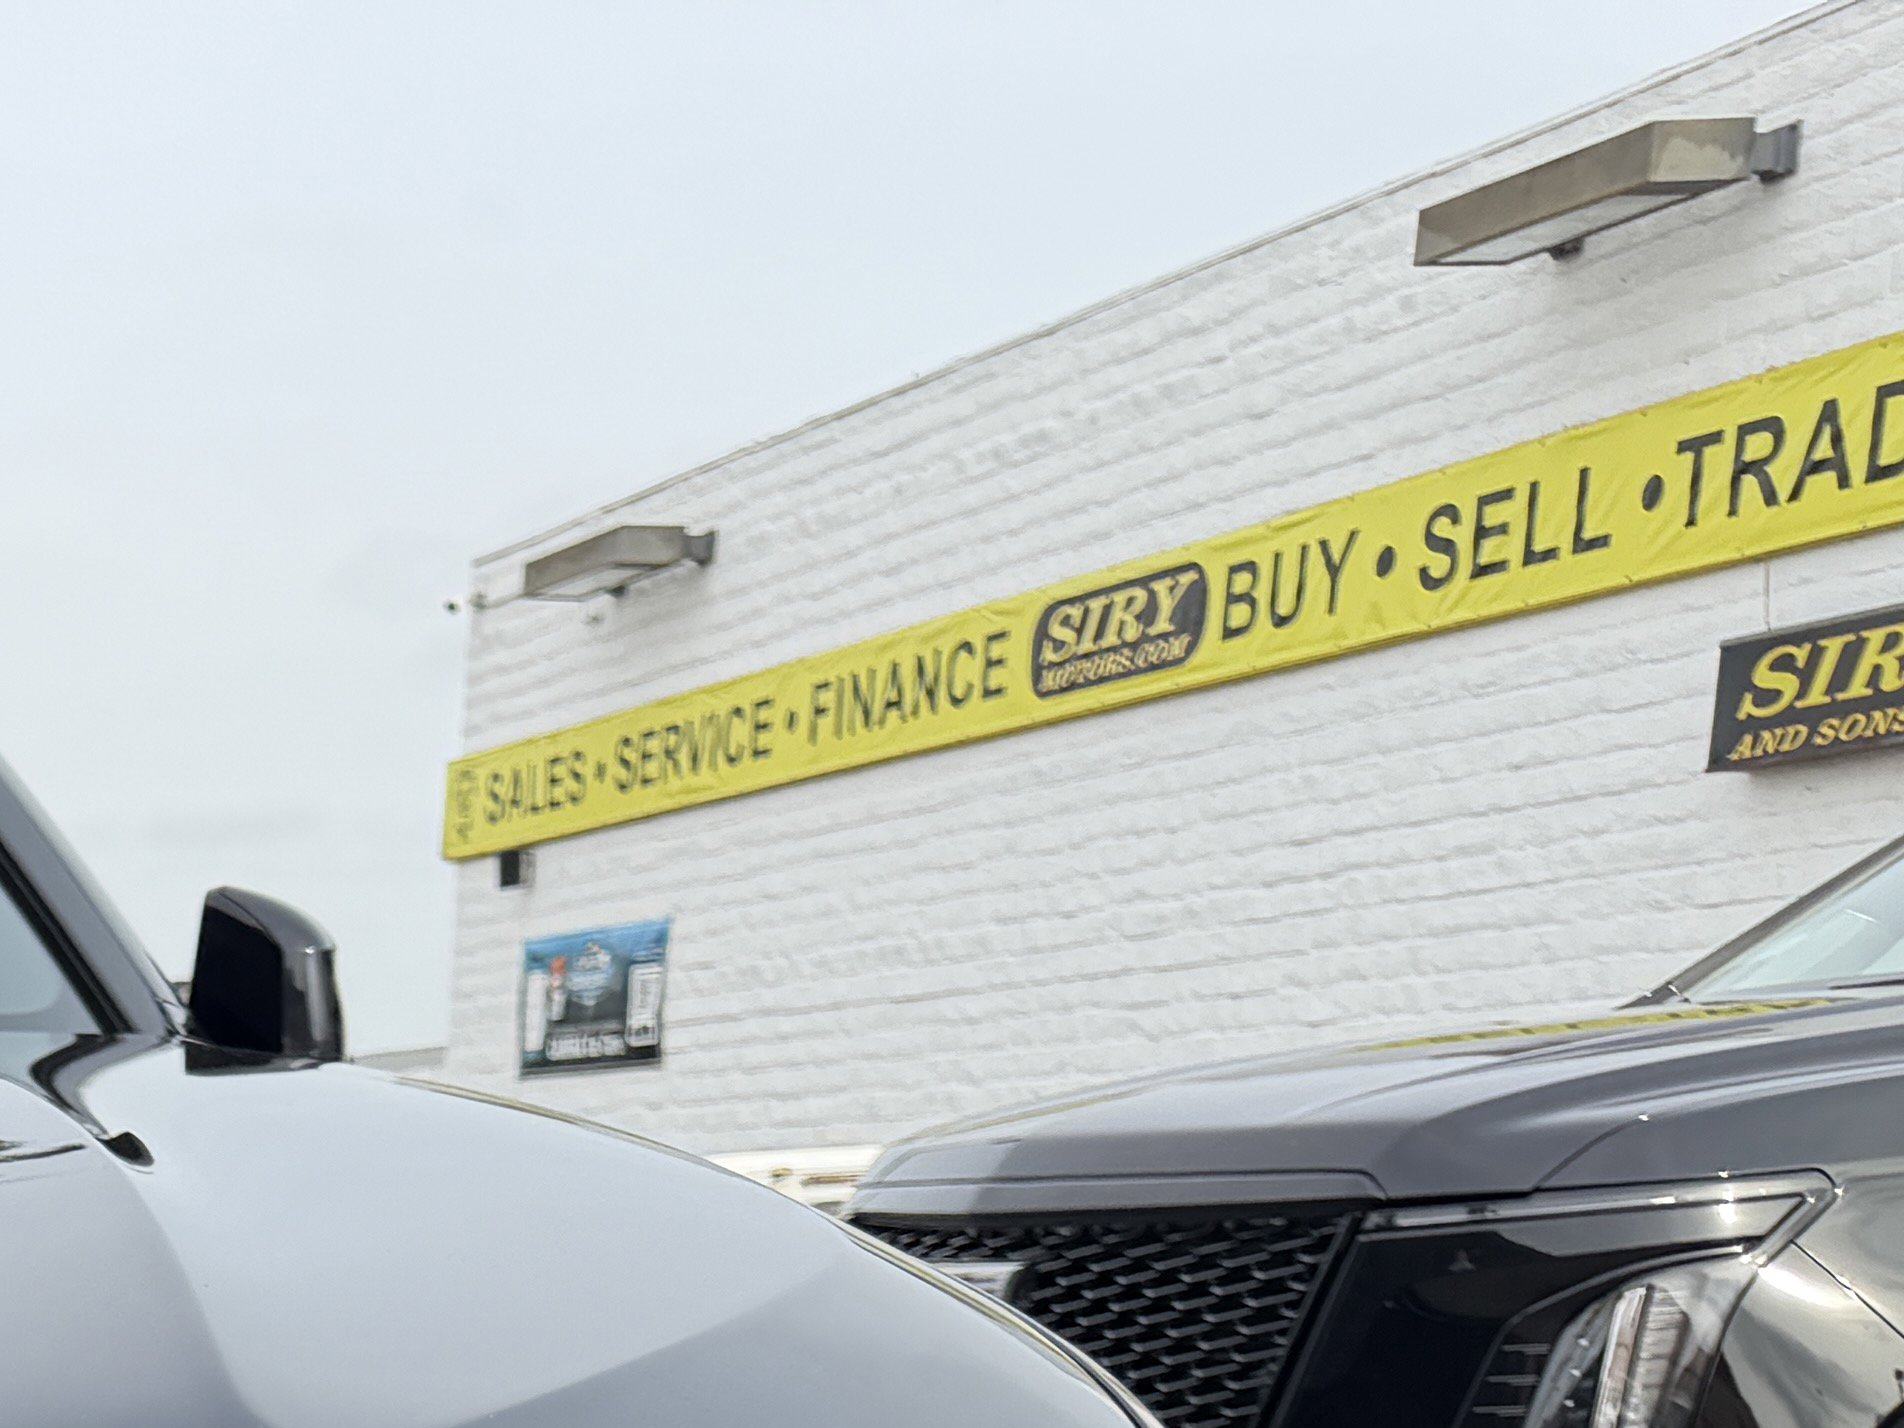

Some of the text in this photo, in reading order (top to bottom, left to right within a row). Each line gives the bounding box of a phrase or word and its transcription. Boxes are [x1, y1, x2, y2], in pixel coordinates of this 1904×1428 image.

[1039, 569, 1200, 666] SIRY
[1220, 527, 1360, 640] BUY
[1418, 466, 1613, 591] SELL
[483, 750, 589, 826] SALES
[613, 696, 776, 795] SERVICE
[806, 629, 1011, 747] FINANCE
[1725, 723, 1809, 762] AND
